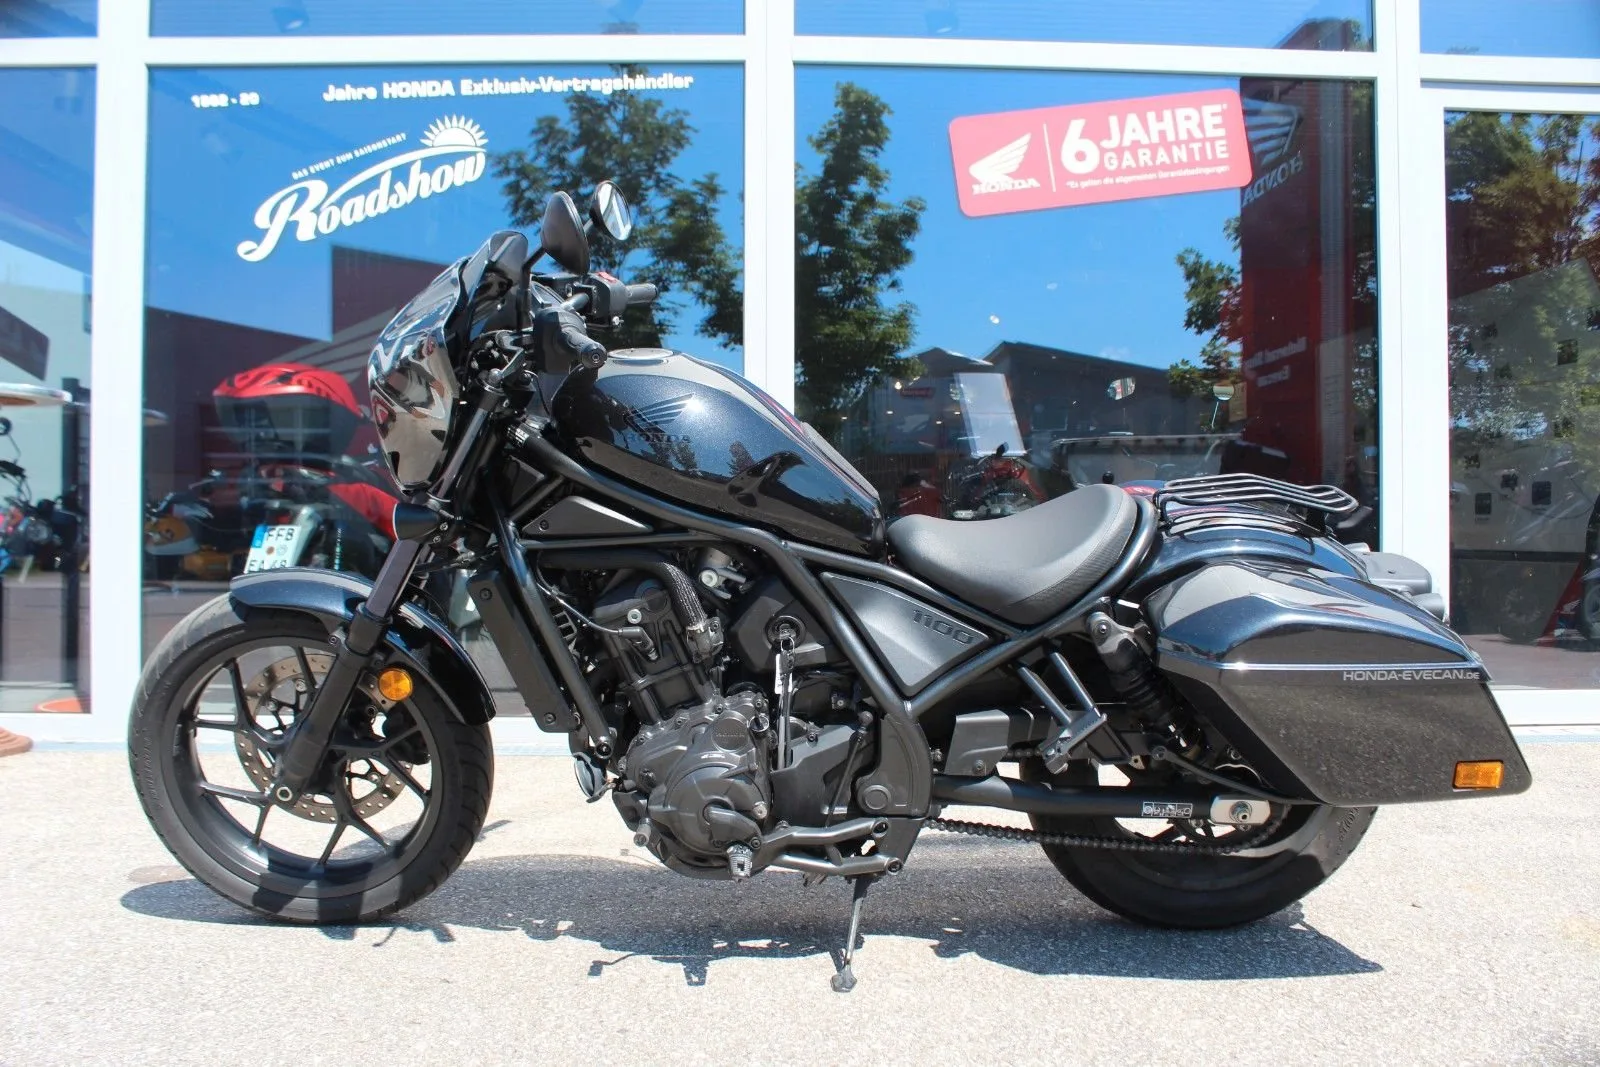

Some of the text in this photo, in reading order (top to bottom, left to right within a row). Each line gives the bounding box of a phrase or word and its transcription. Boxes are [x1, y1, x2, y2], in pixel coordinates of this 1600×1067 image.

[322, 84, 378, 102] Jahre
[382, 79, 456, 99] HONDA
[291, 132, 407, 180] DAS EVENT ZUM SAISONSTART
[1060, 118, 1100, 174] 6
[1103, 140, 1229, 171] GARANTIE
[972, 178, 1041, 196] HONDA
[237, 152, 486, 262] Roadshow
[266, 528, 295, 541] FFB
[913, 608, 975, 645] 1100
[1343, 669, 1481, 681] HONDA-EVECAN.DE
